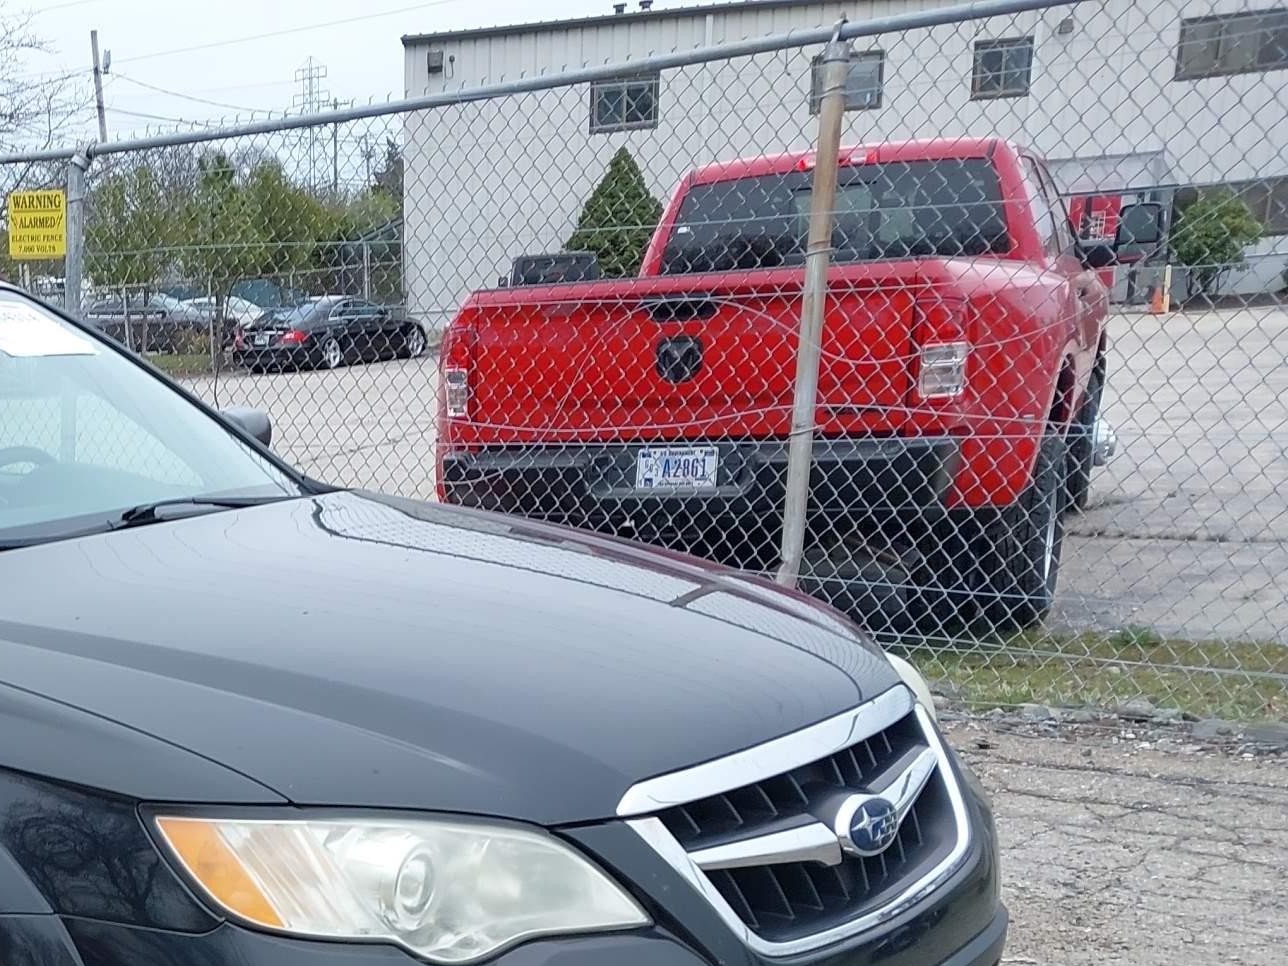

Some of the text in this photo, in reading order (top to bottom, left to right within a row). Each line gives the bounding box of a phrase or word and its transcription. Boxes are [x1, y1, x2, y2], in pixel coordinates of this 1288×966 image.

[12, 194, 62, 209] WARNING
[18, 216, 56, 229] ALARMED
[12, 234, 63, 243] ELECTRIC FENCE
[36, 244, 57, 253] VOLTS
[661, 457, 707, 478] A2861
